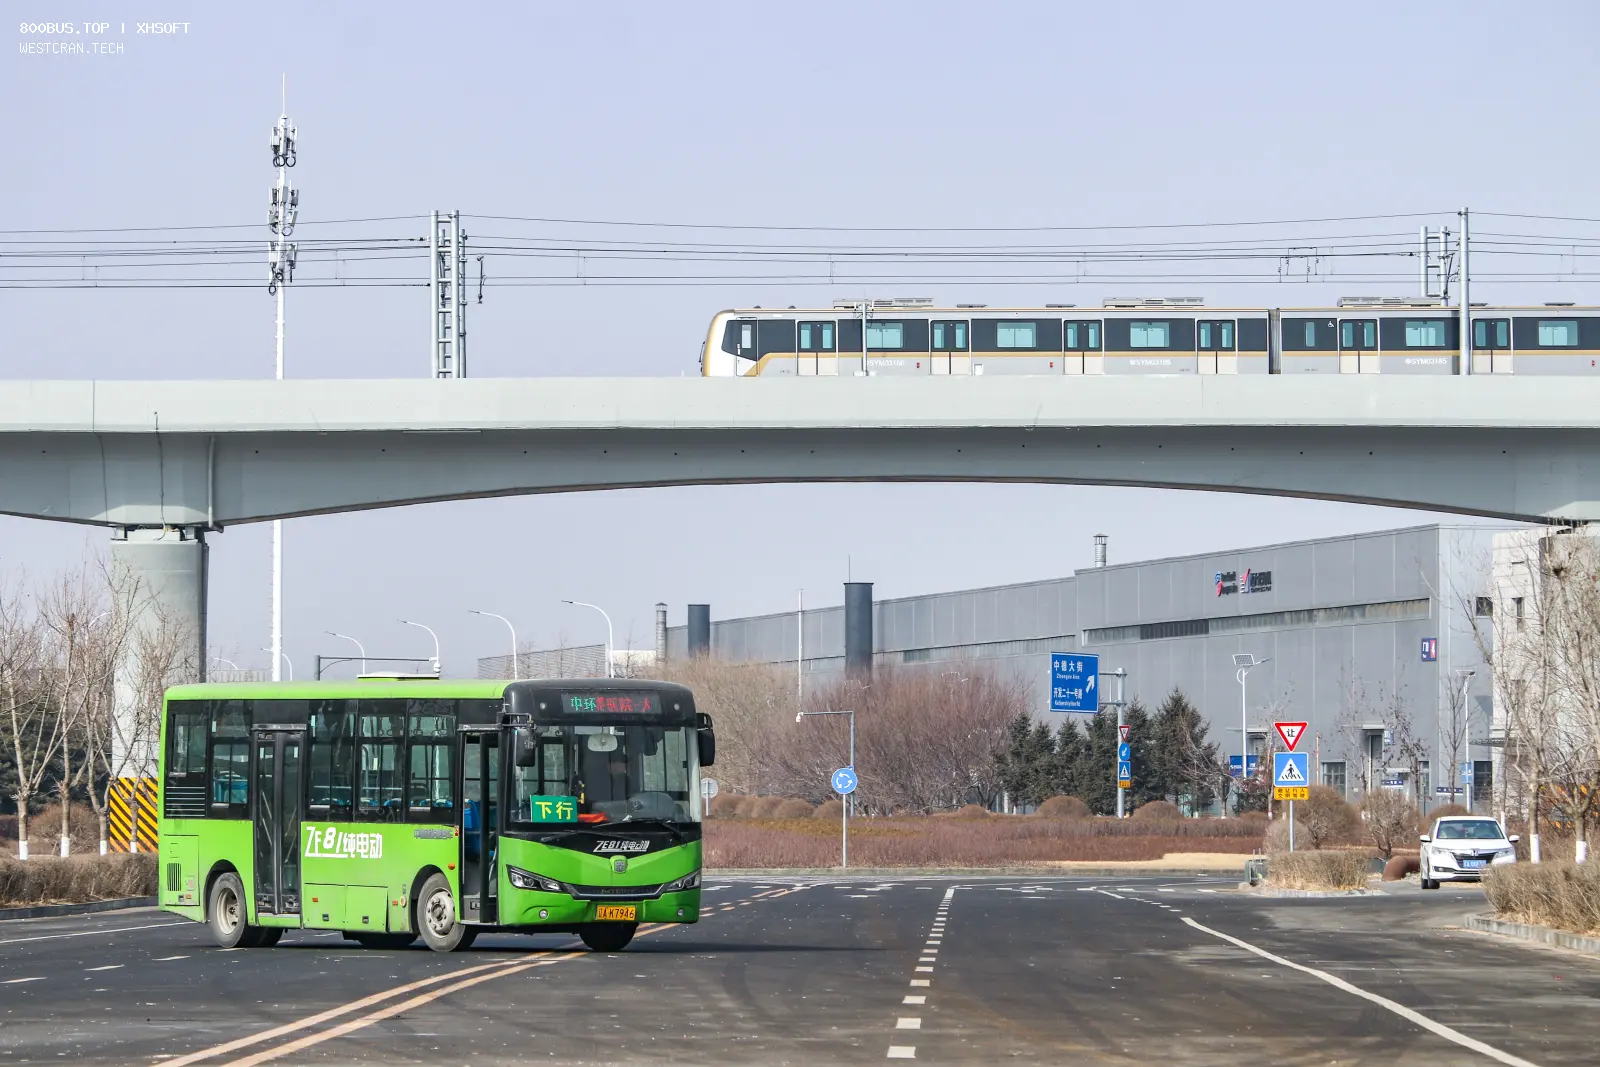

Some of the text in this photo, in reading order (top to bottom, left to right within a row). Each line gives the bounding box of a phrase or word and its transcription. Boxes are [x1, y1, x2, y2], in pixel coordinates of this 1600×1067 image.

[1053, 659, 1083, 673] 中德大街
[1286, 728, 1296, 738] 让
[535, 801, 573, 820] 下行
